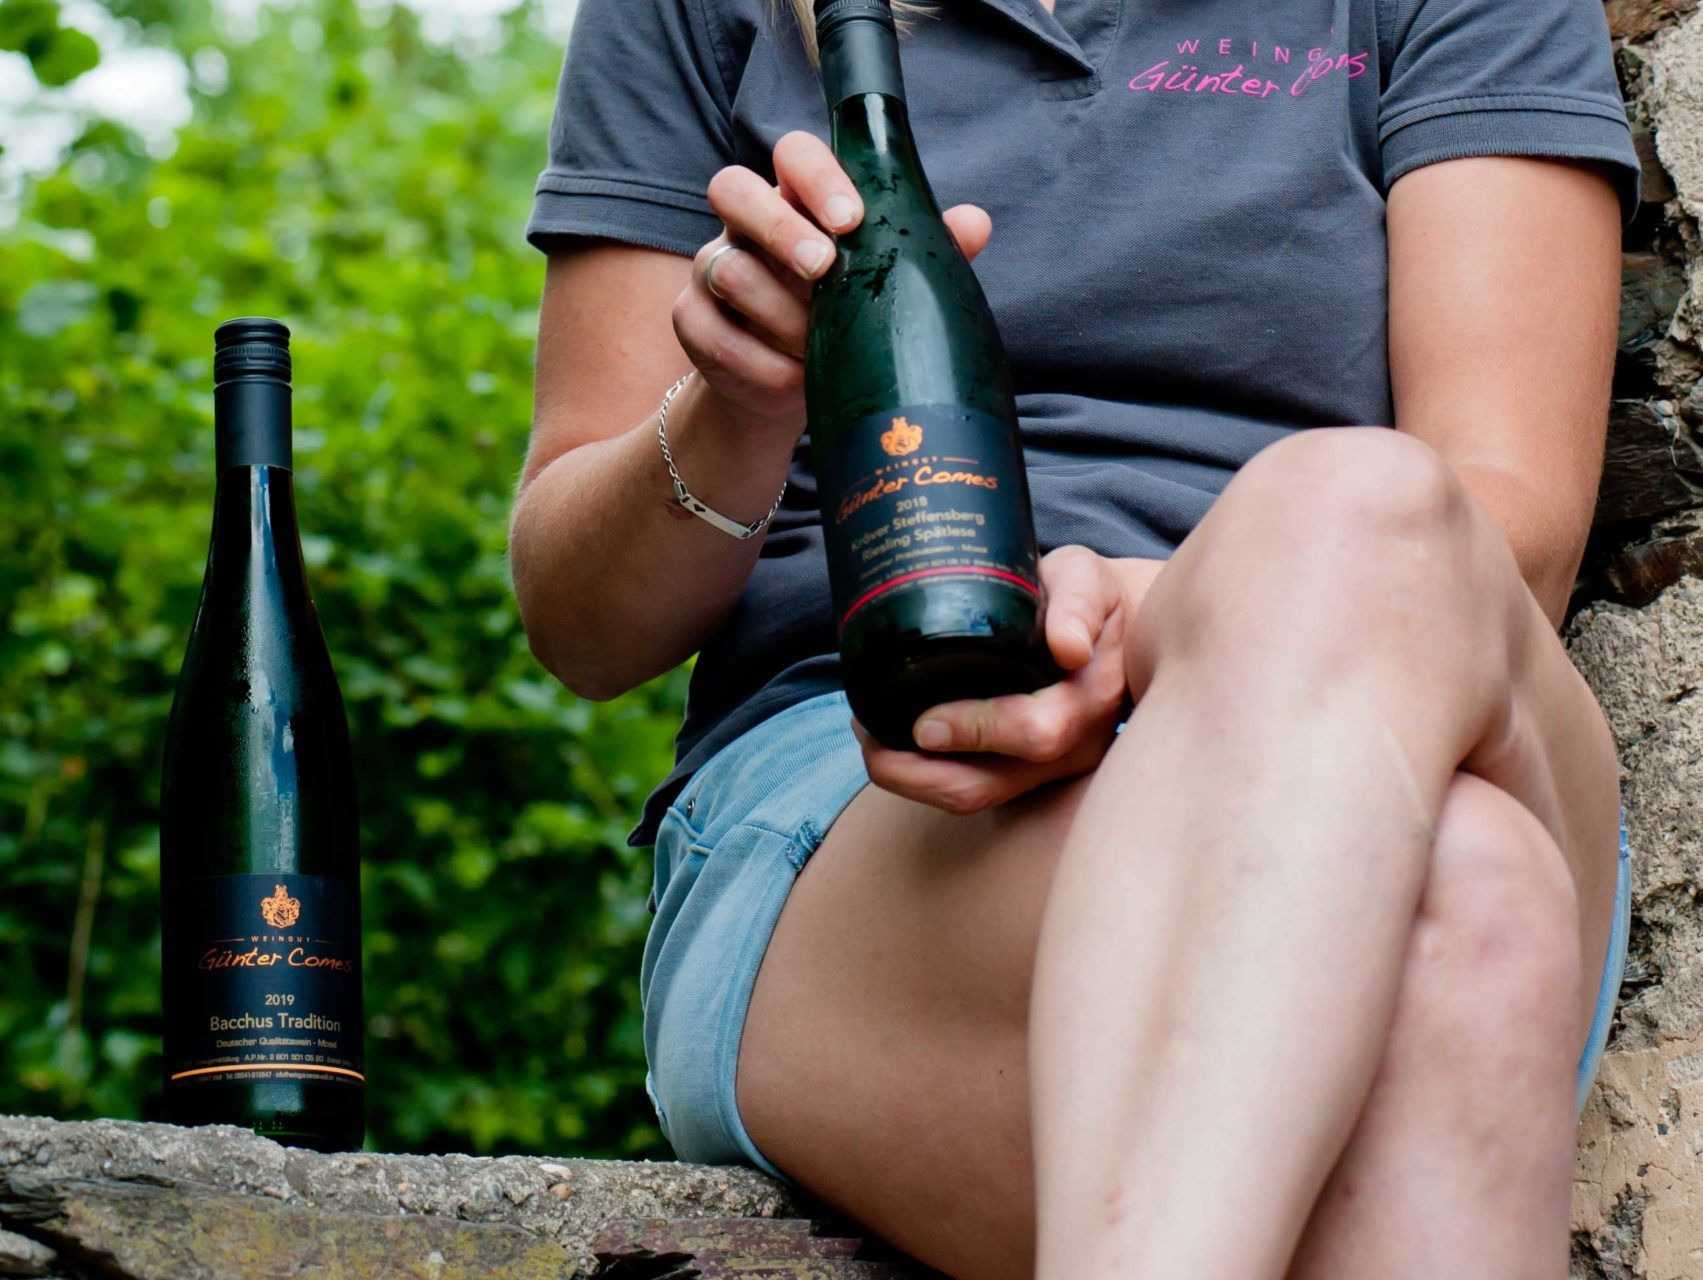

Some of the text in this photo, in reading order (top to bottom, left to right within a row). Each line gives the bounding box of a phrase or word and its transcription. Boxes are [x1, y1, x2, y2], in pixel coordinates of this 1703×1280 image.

[1128, 61, 1280, 98] Günter
[914, 466, 998, 489] Comes
[893, 509, 985, 531] Steffensberg
[199, 947, 352, 973] Günter Comes
[265, 994, 295, 1006] 2019
[210, 1012, 341, 1032] Bacchus Tradition
